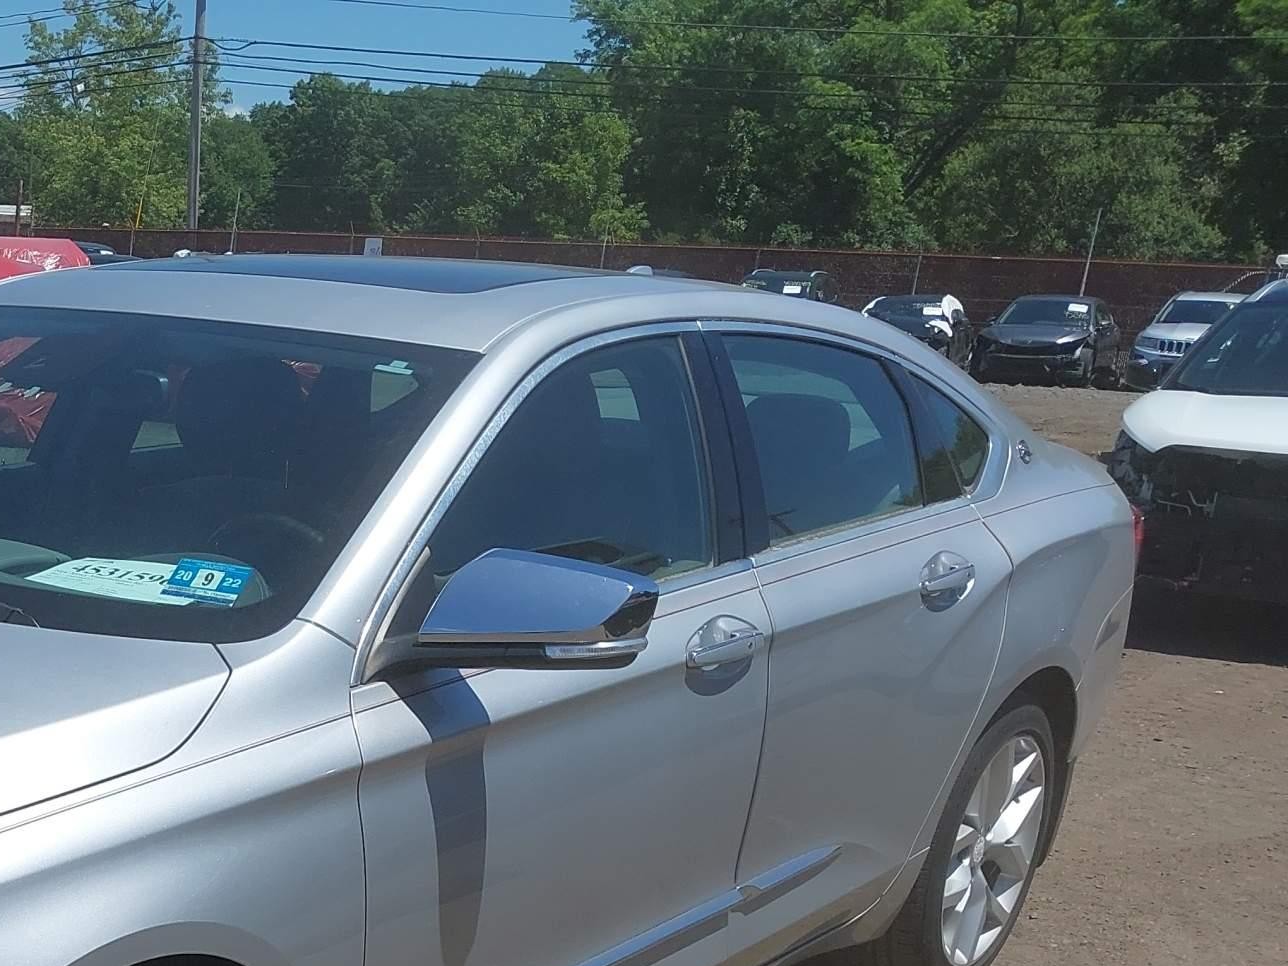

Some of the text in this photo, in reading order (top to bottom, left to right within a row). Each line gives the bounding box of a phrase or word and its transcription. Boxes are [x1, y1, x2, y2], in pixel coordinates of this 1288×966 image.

[174, 569, 242, 588] 20 9 22
